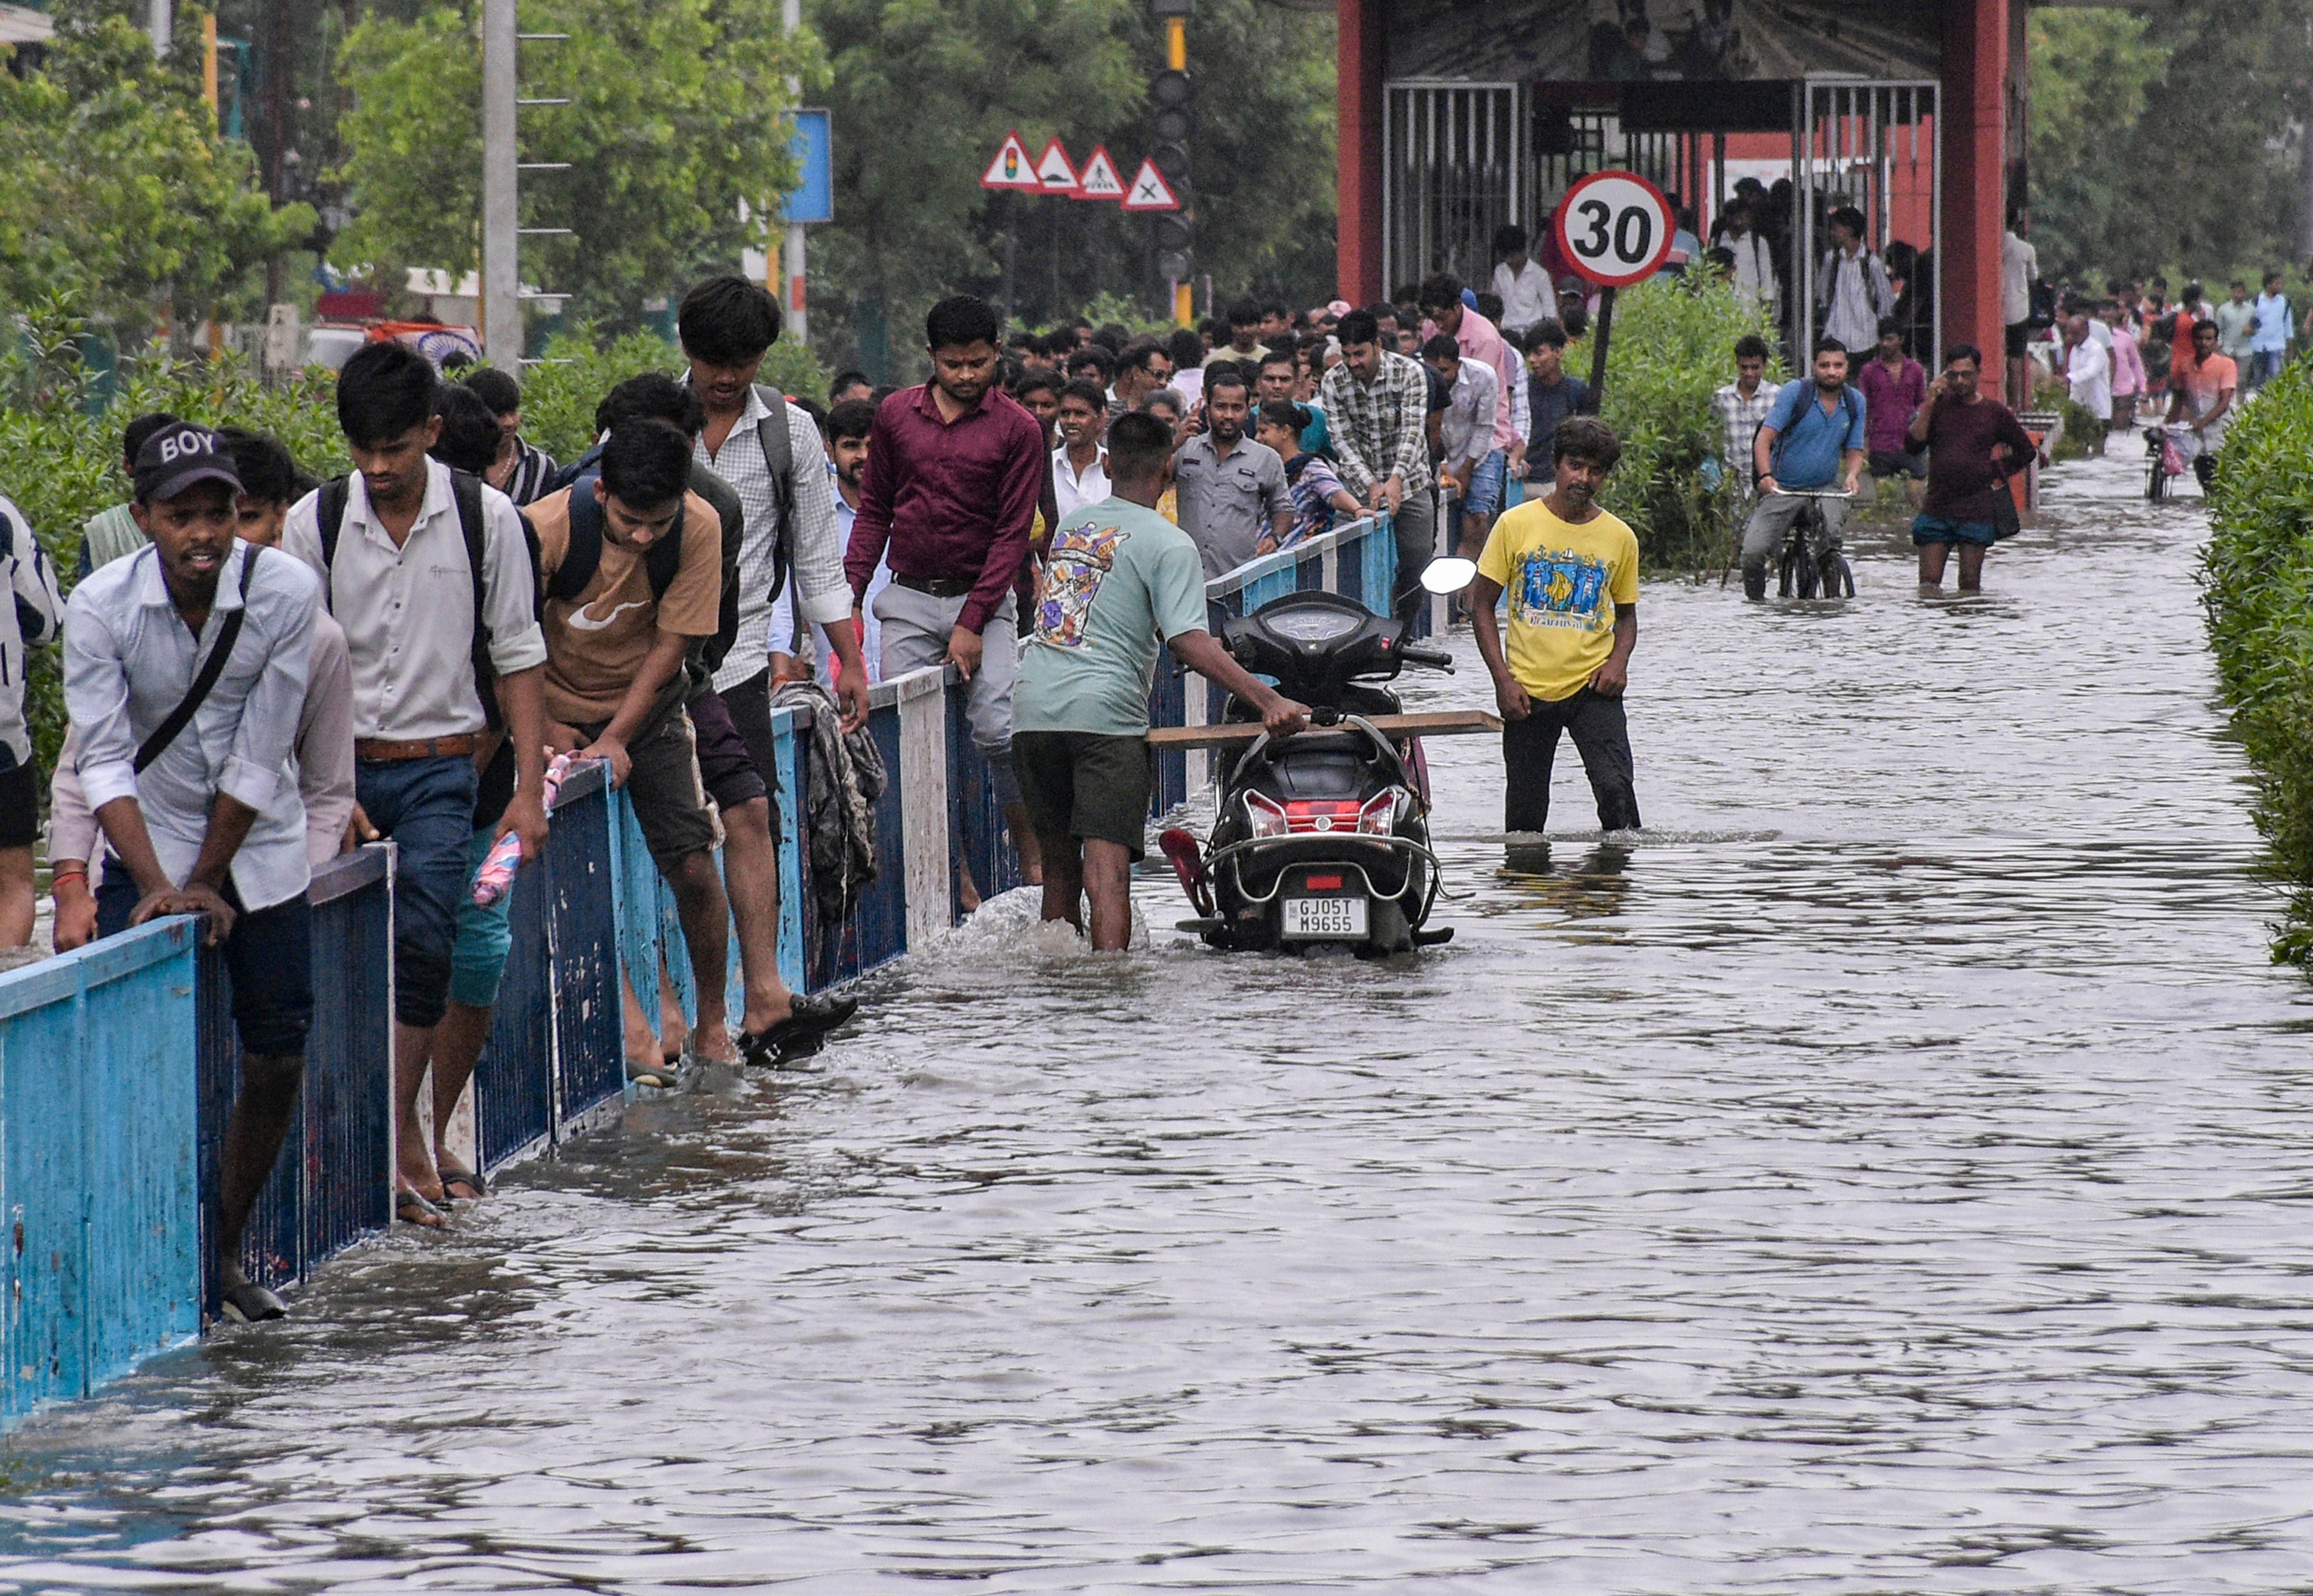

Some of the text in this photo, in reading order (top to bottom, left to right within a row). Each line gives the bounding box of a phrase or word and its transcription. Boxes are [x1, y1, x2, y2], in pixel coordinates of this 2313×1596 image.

[1573, 200, 1651, 264] 30
[161, 430, 213, 463] BOY
[1300, 900, 1351, 915] GJ05T
[1301, 917, 1352, 931] M9655
